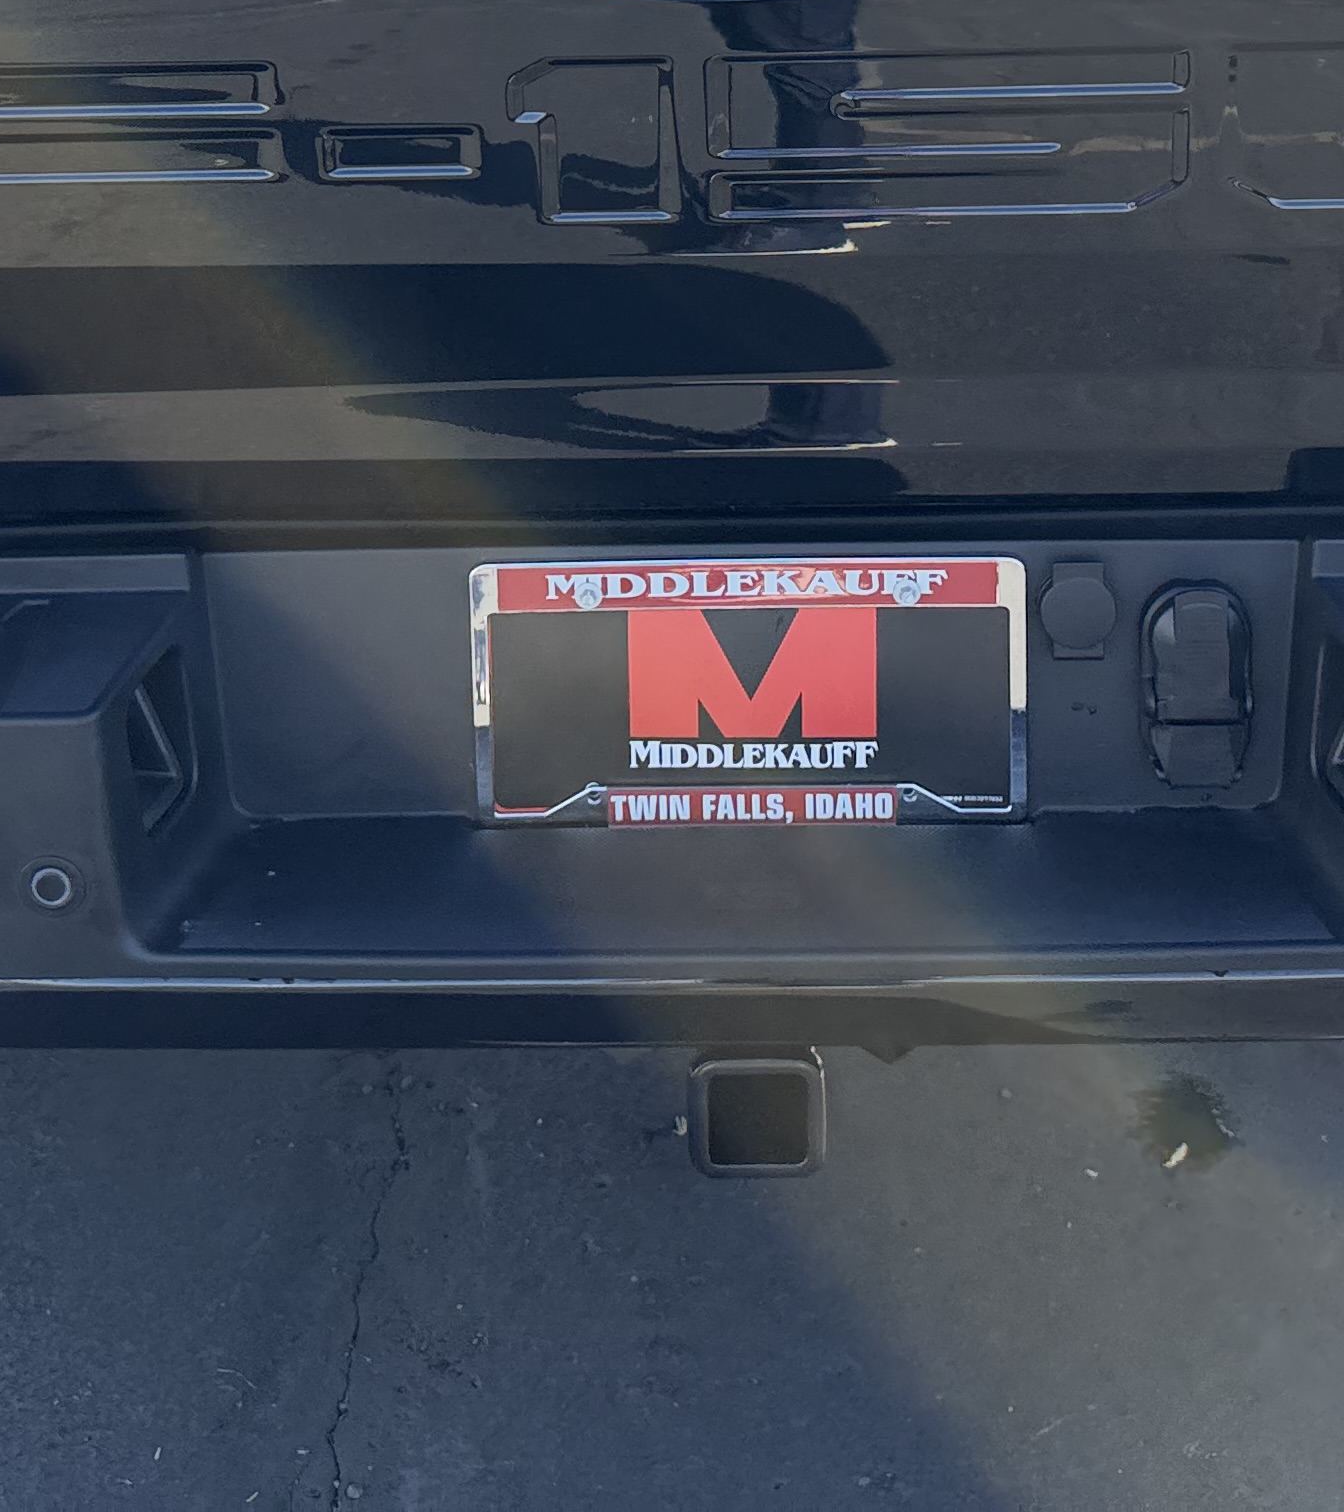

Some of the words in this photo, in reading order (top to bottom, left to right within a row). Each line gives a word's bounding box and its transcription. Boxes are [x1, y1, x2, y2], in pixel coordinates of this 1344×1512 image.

[627, 607, 878, 738] M
[628, 740, 879, 769] MIDDLEKAUFF
[609, 794, 691, 821] TWIN
[702, 793, 794, 824] FALLS,
[805, 792, 894, 820] IDAHO
